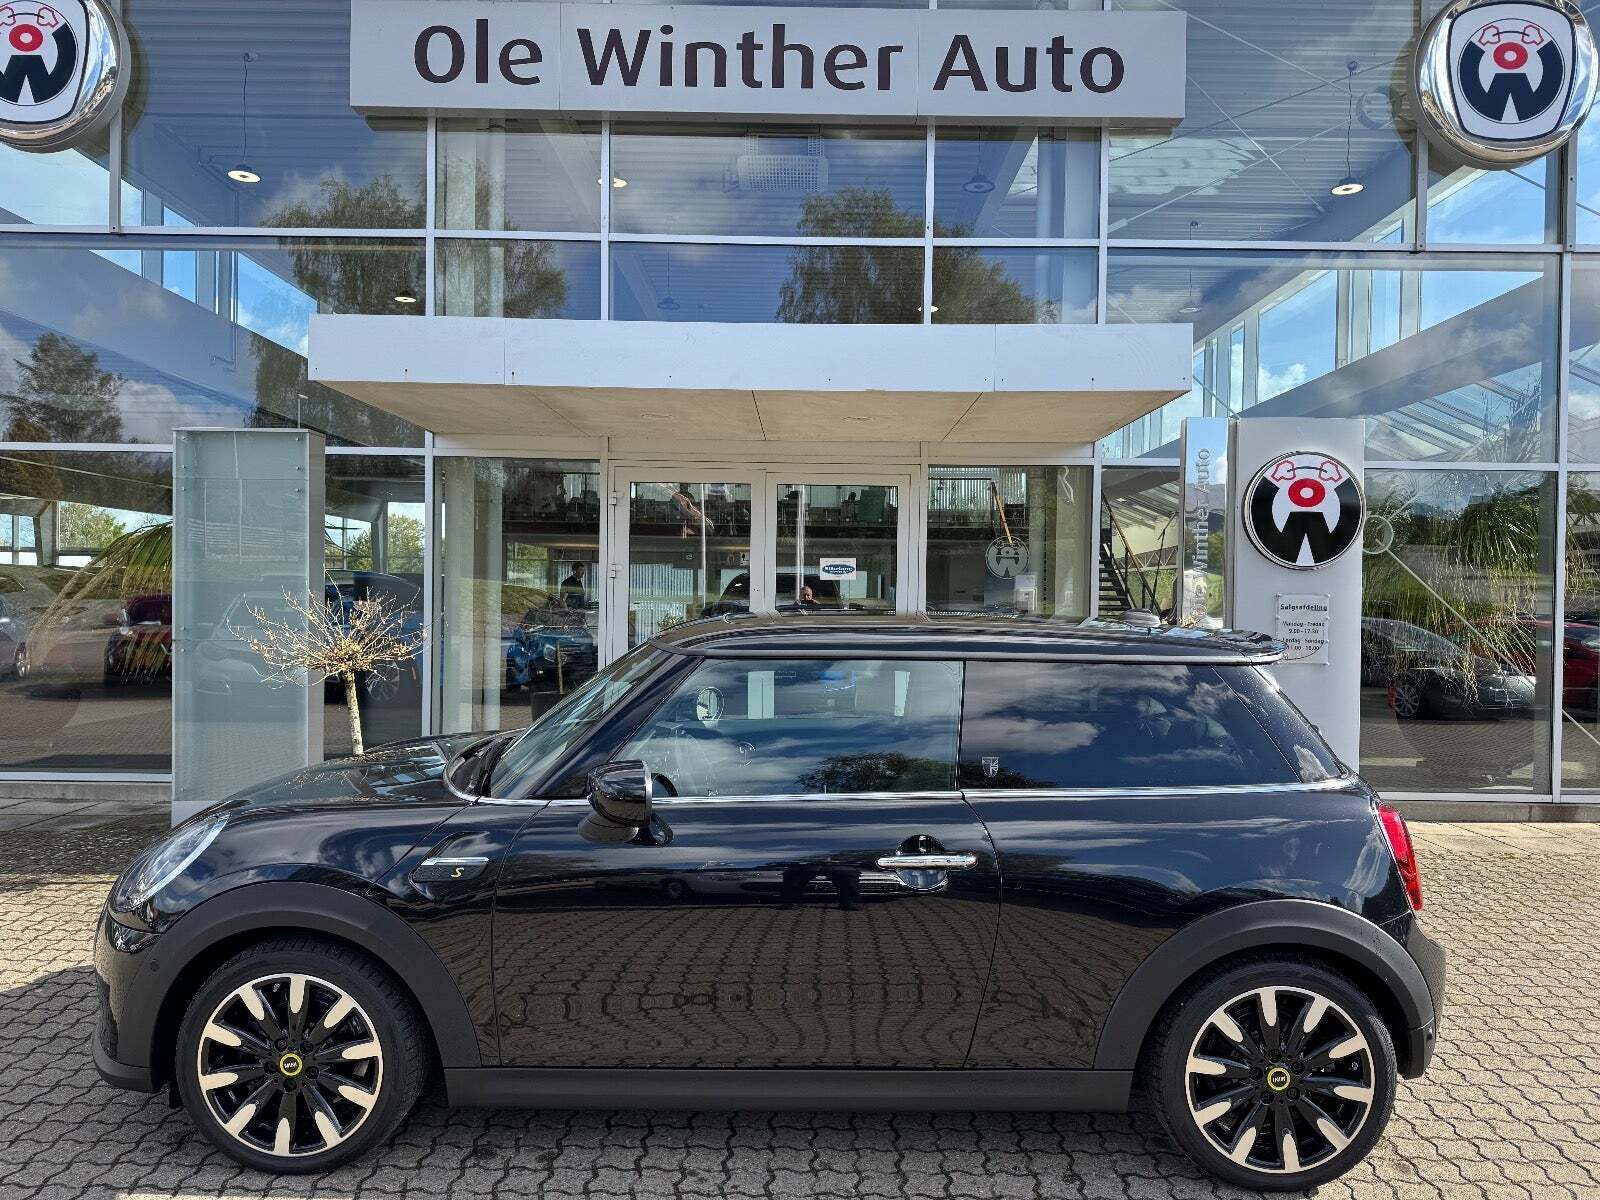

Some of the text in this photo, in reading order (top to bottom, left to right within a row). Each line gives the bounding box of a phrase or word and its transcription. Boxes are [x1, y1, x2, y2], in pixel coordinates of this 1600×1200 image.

[414, 19, 1125, 94] Ole Winther Auto
[1194, 448, 1210, 493] Auto
[1191, 500, 1209, 578] Winther
[450, 866, 465, 878] S
